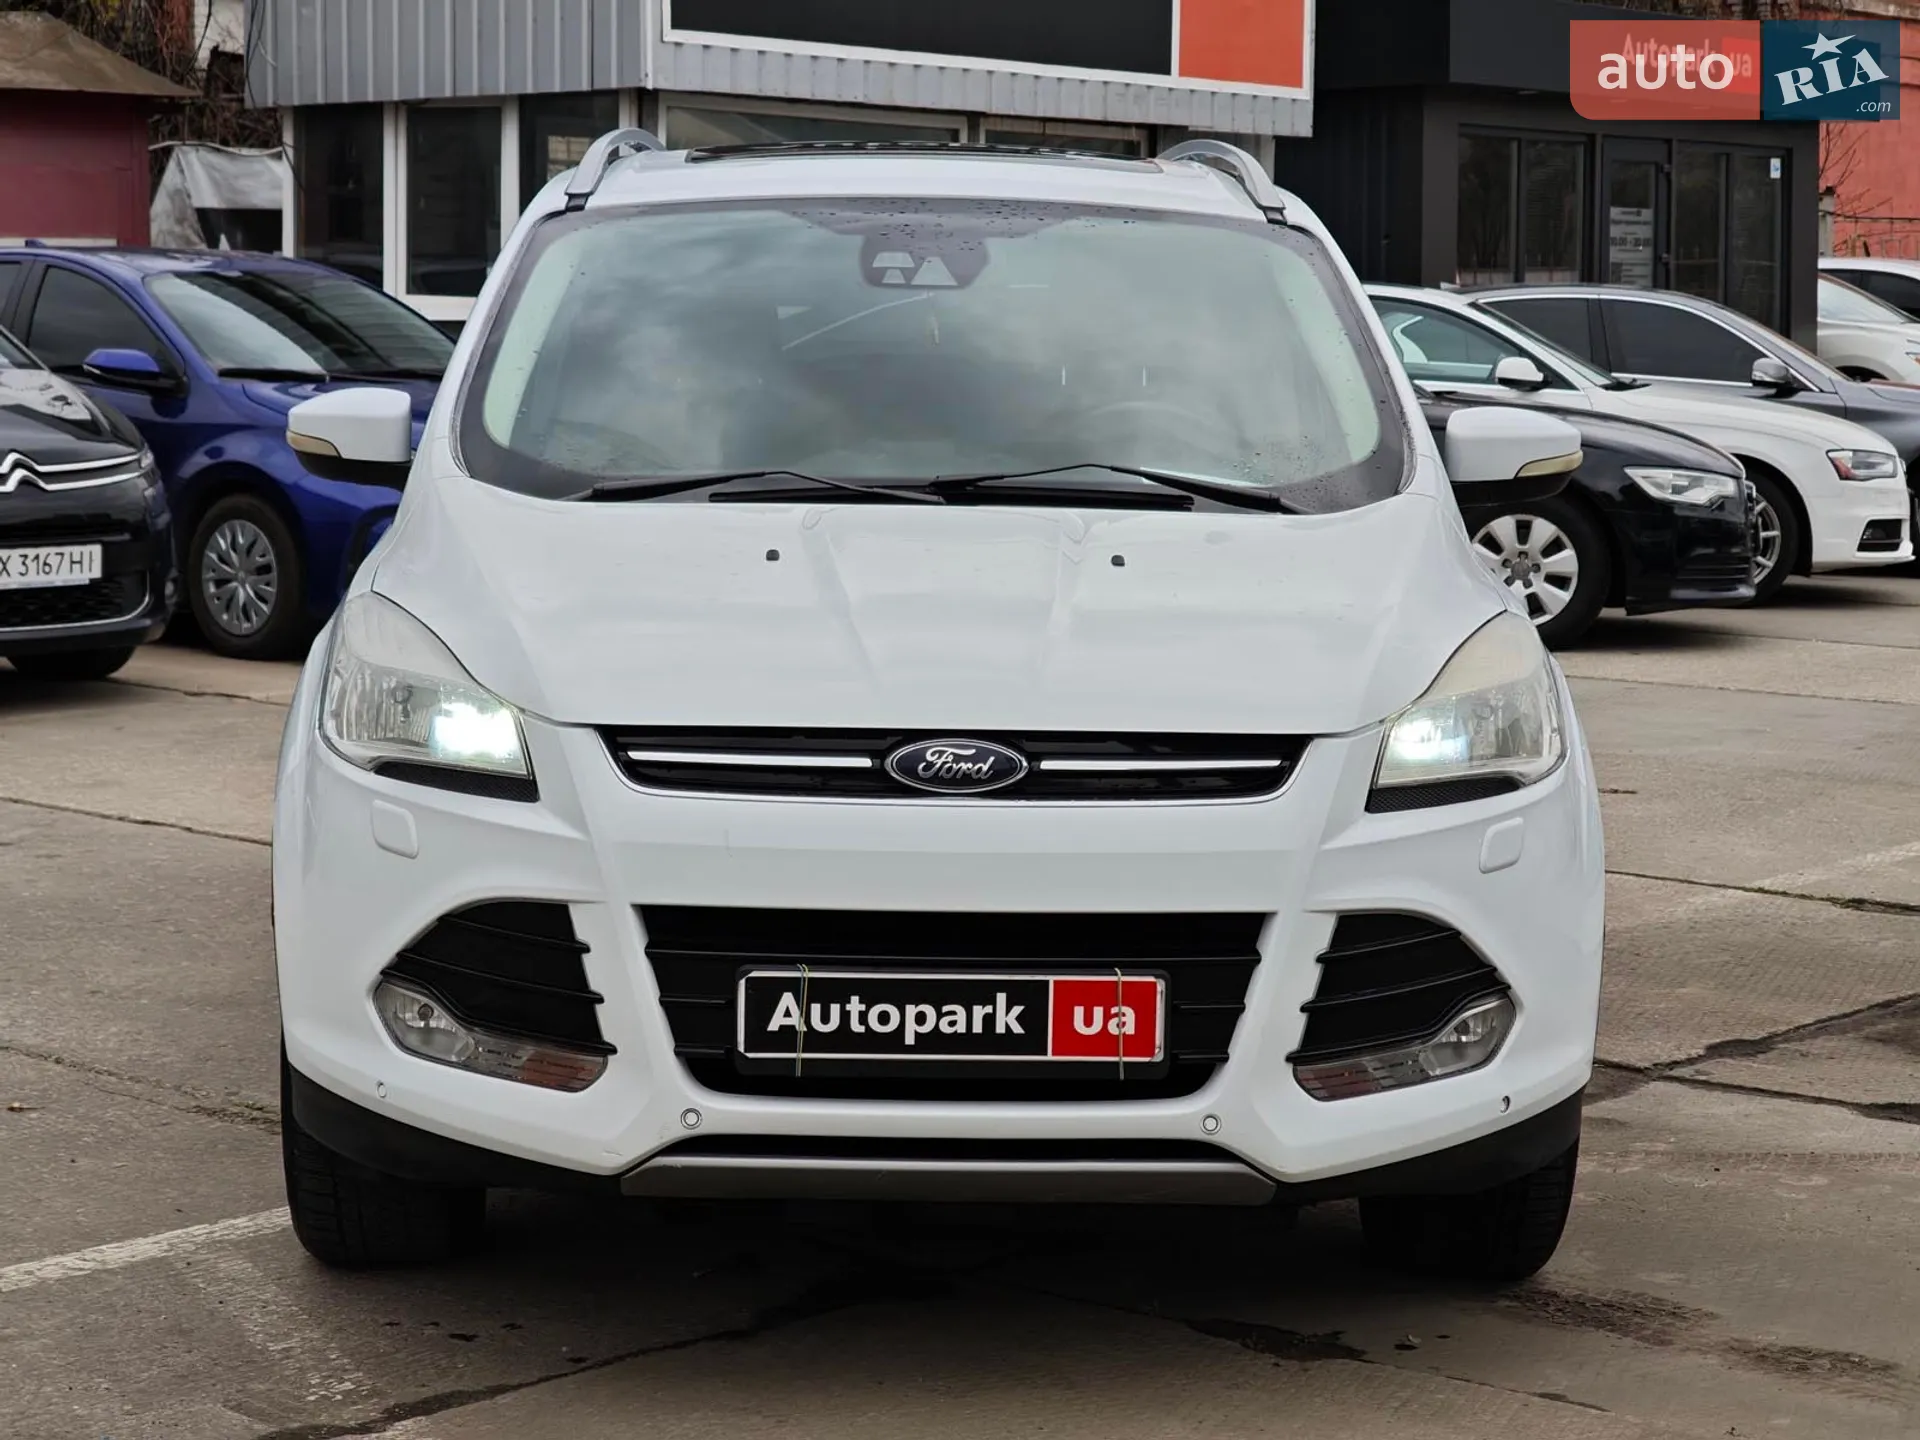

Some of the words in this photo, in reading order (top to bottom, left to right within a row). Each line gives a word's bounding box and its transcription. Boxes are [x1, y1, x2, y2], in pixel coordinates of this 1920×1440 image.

[1622, 33, 1716, 77] Autopark
[917, 746, 996, 780] Ford
[767, 991, 1026, 1046] Autopark
[1073, 1004, 1136, 1036] ua
